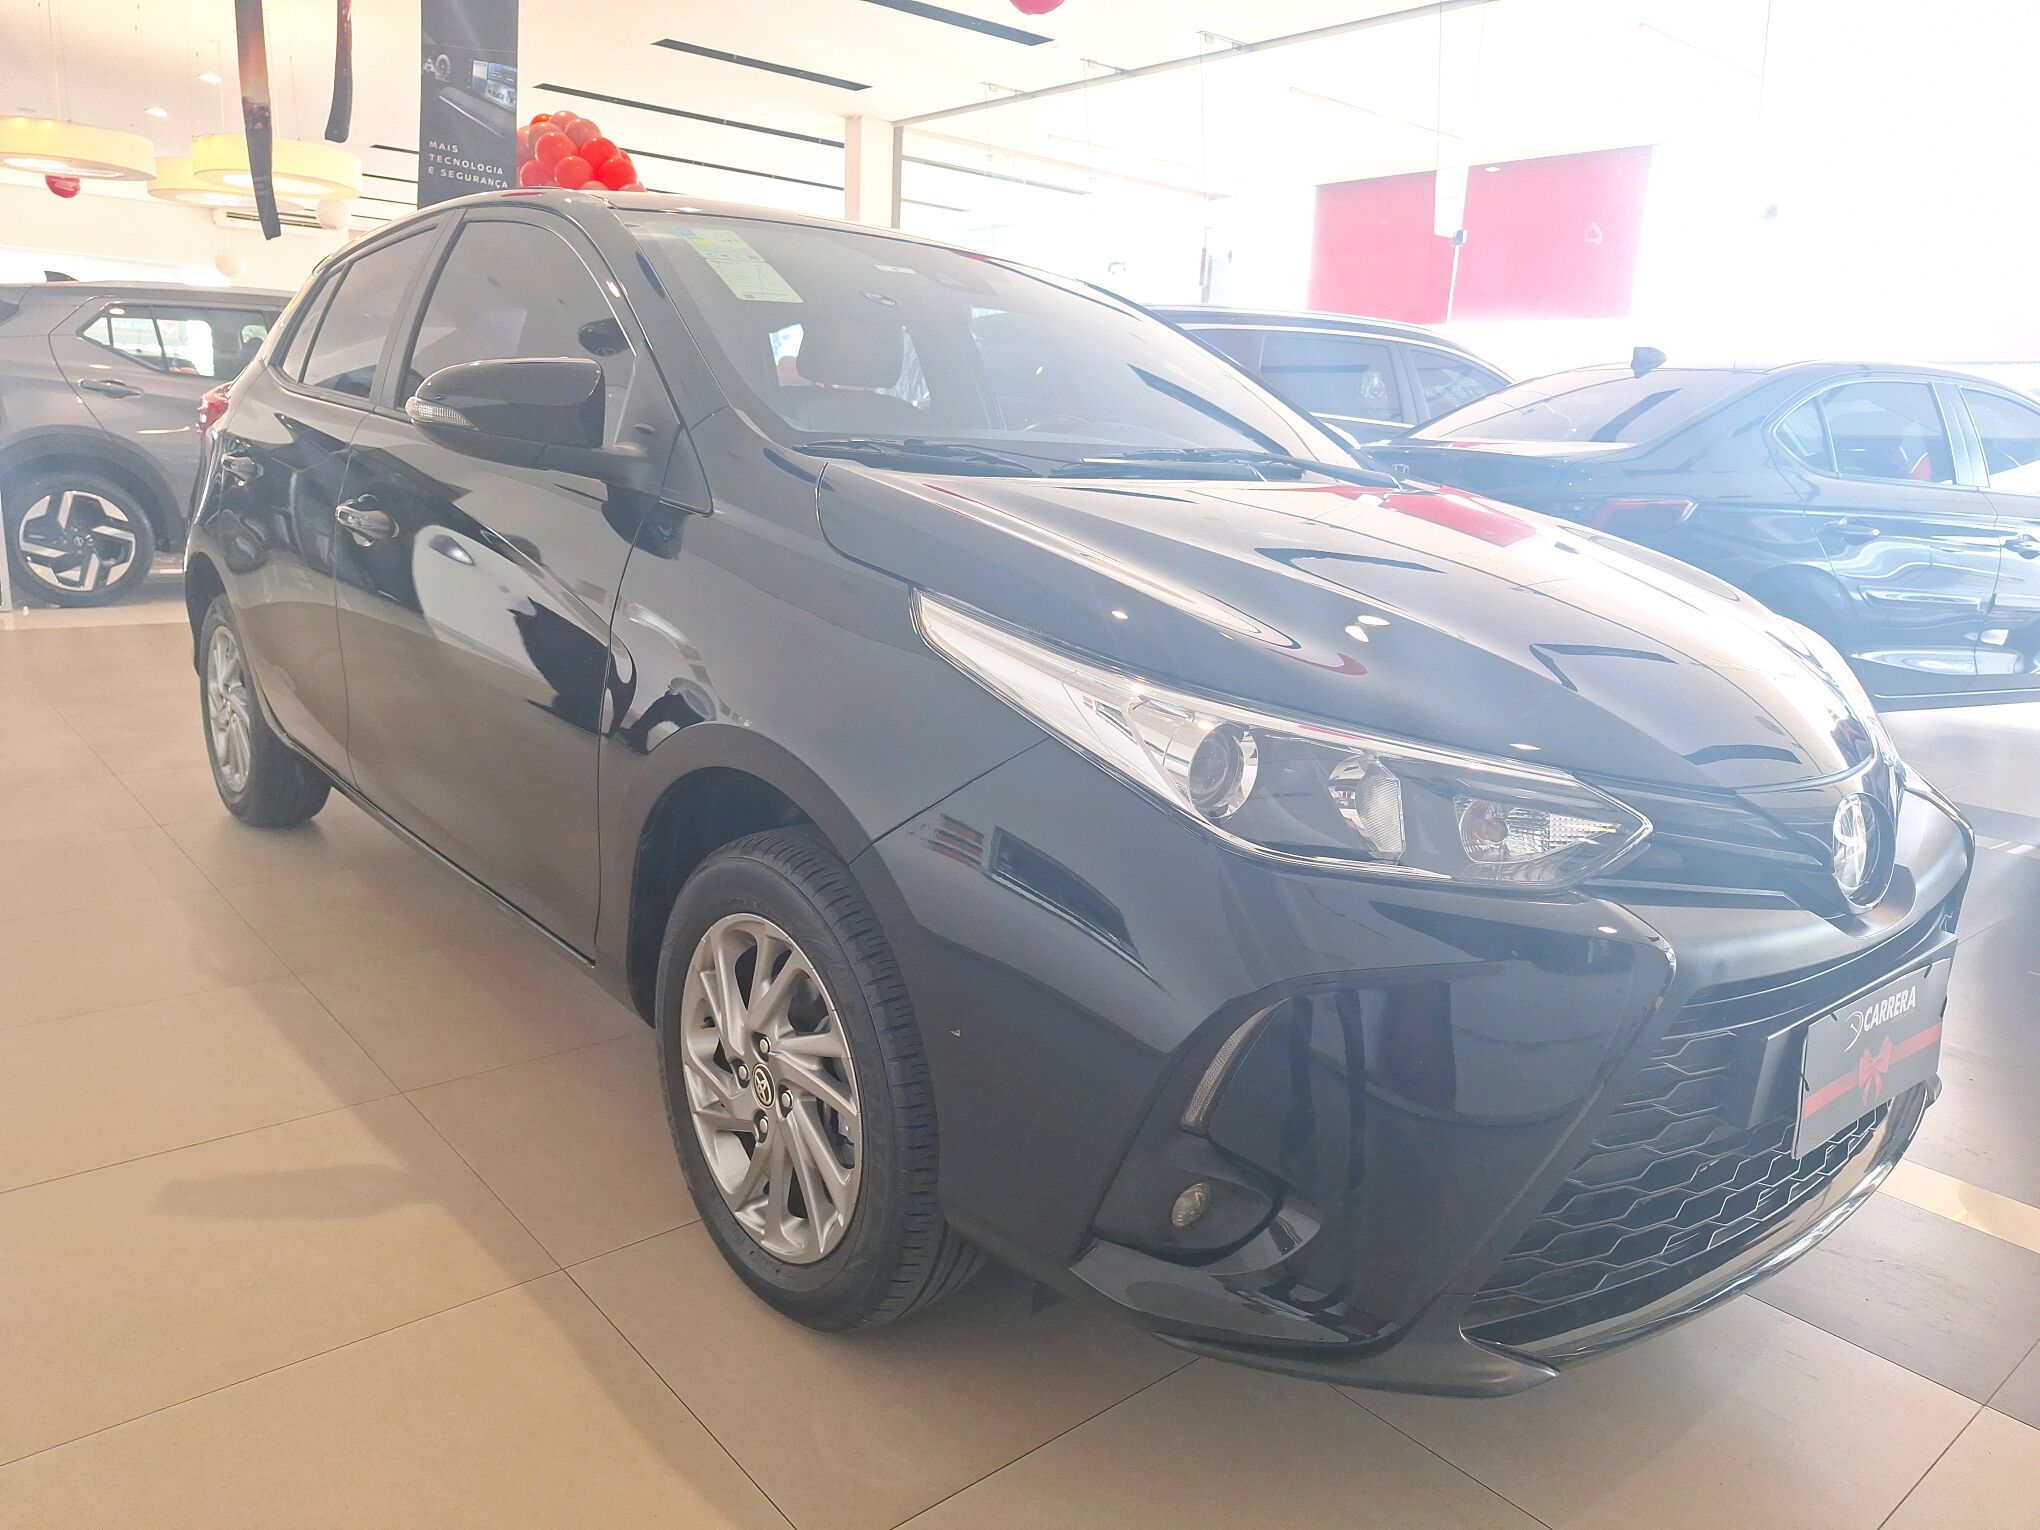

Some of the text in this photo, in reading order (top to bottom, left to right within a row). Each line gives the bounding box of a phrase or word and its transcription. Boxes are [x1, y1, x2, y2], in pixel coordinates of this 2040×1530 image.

[428, 141, 459, 153] MAIS
[429, 154, 504, 175] TECNOLOGIA
[427, 166, 508, 189] E SEGURANÇA
[1864, 985, 1916, 1032] CARRERA
